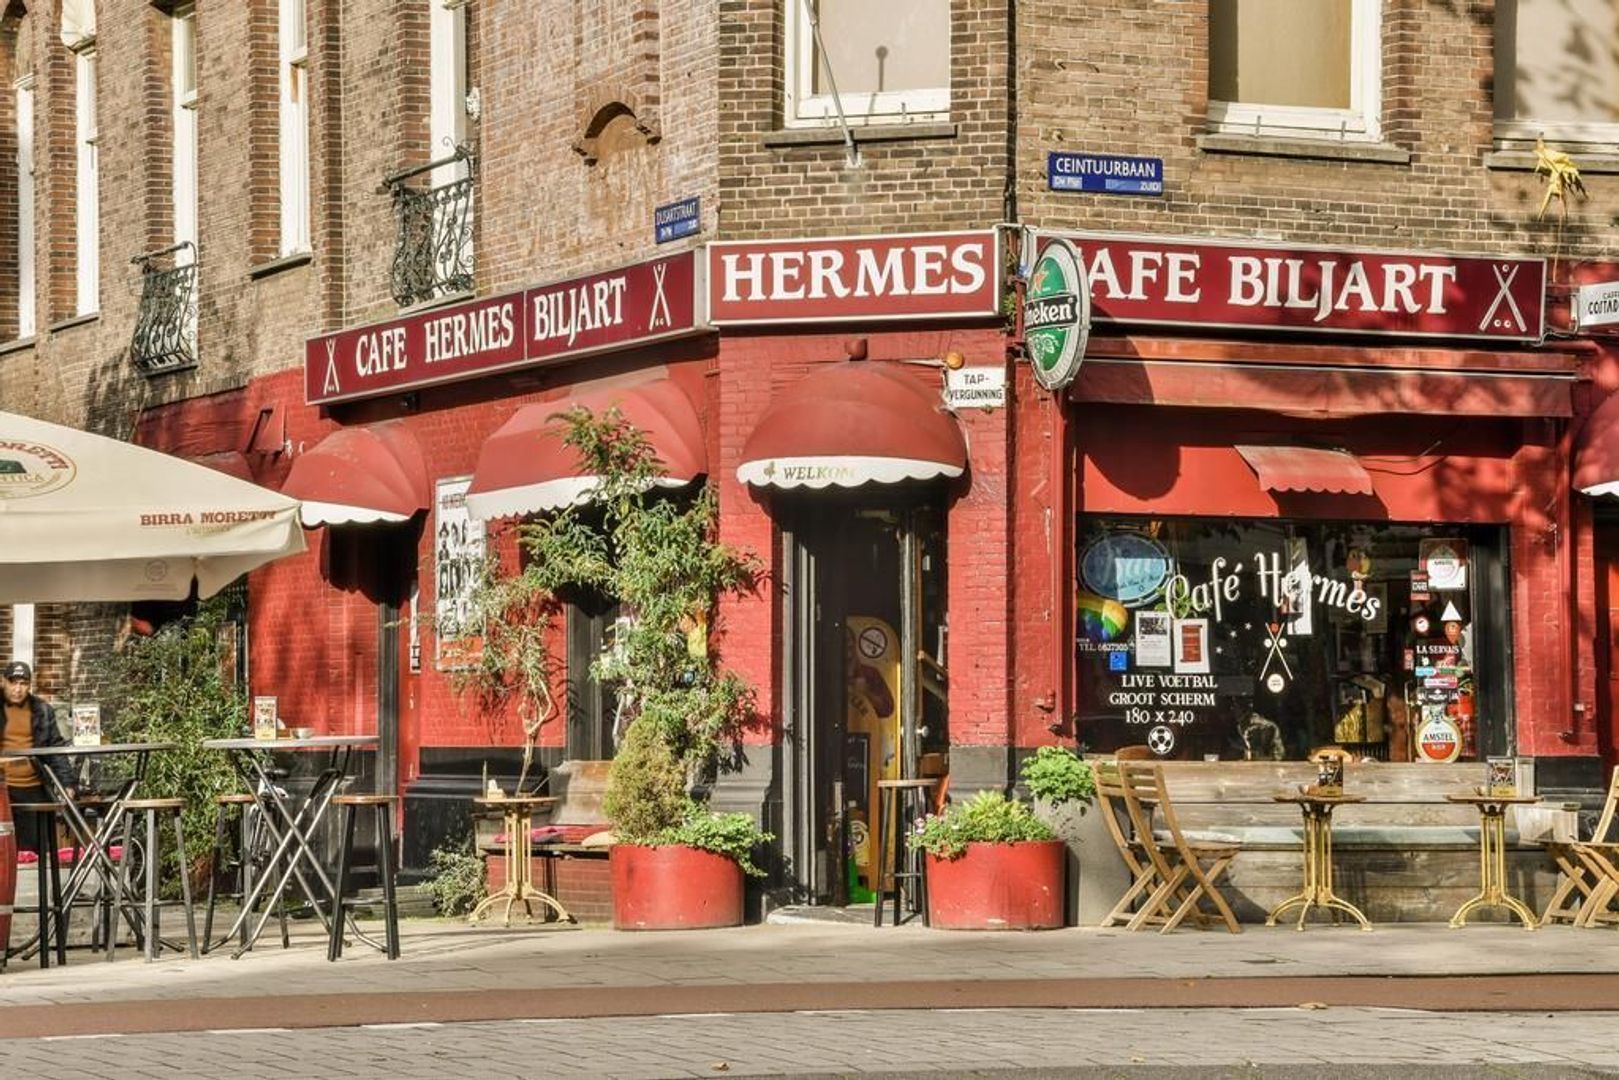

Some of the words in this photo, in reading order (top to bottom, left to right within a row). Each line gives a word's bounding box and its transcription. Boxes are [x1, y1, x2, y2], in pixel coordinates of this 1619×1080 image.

[1056, 158, 1155, 177] CEINTUURBAAN
[721, 243, 986, 301] HERMES
[1085, 247, 1201, 303] AFE
[1227, 256, 1456, 322] BILJART
[354, 327, 408, 378] CAFE
[424, 302, 515, 363] HERMES
[533, 276, 627, 348] BILJART
[964, 373, 990, 384] TAP-
[949, 388, 1003, 400] VERGUNNING
[140, 513, 193, 525] BIRRA
[1165, 556, 1243, 622] Café
[1254, 552, 1381, 620] Hermes
[1121, 674, 1156, 688] LIVE
[1158, 674, 1218, 688] VOETBAL
[1109, 692, 1156, 706] GROOT
[1160, 692, 1216, 706] SCHERM
[1125, 707, 1151, 724] 180
[1168, 710, 1194, 727] 240
[1423, 732, 1454, 742] AMSTEL
